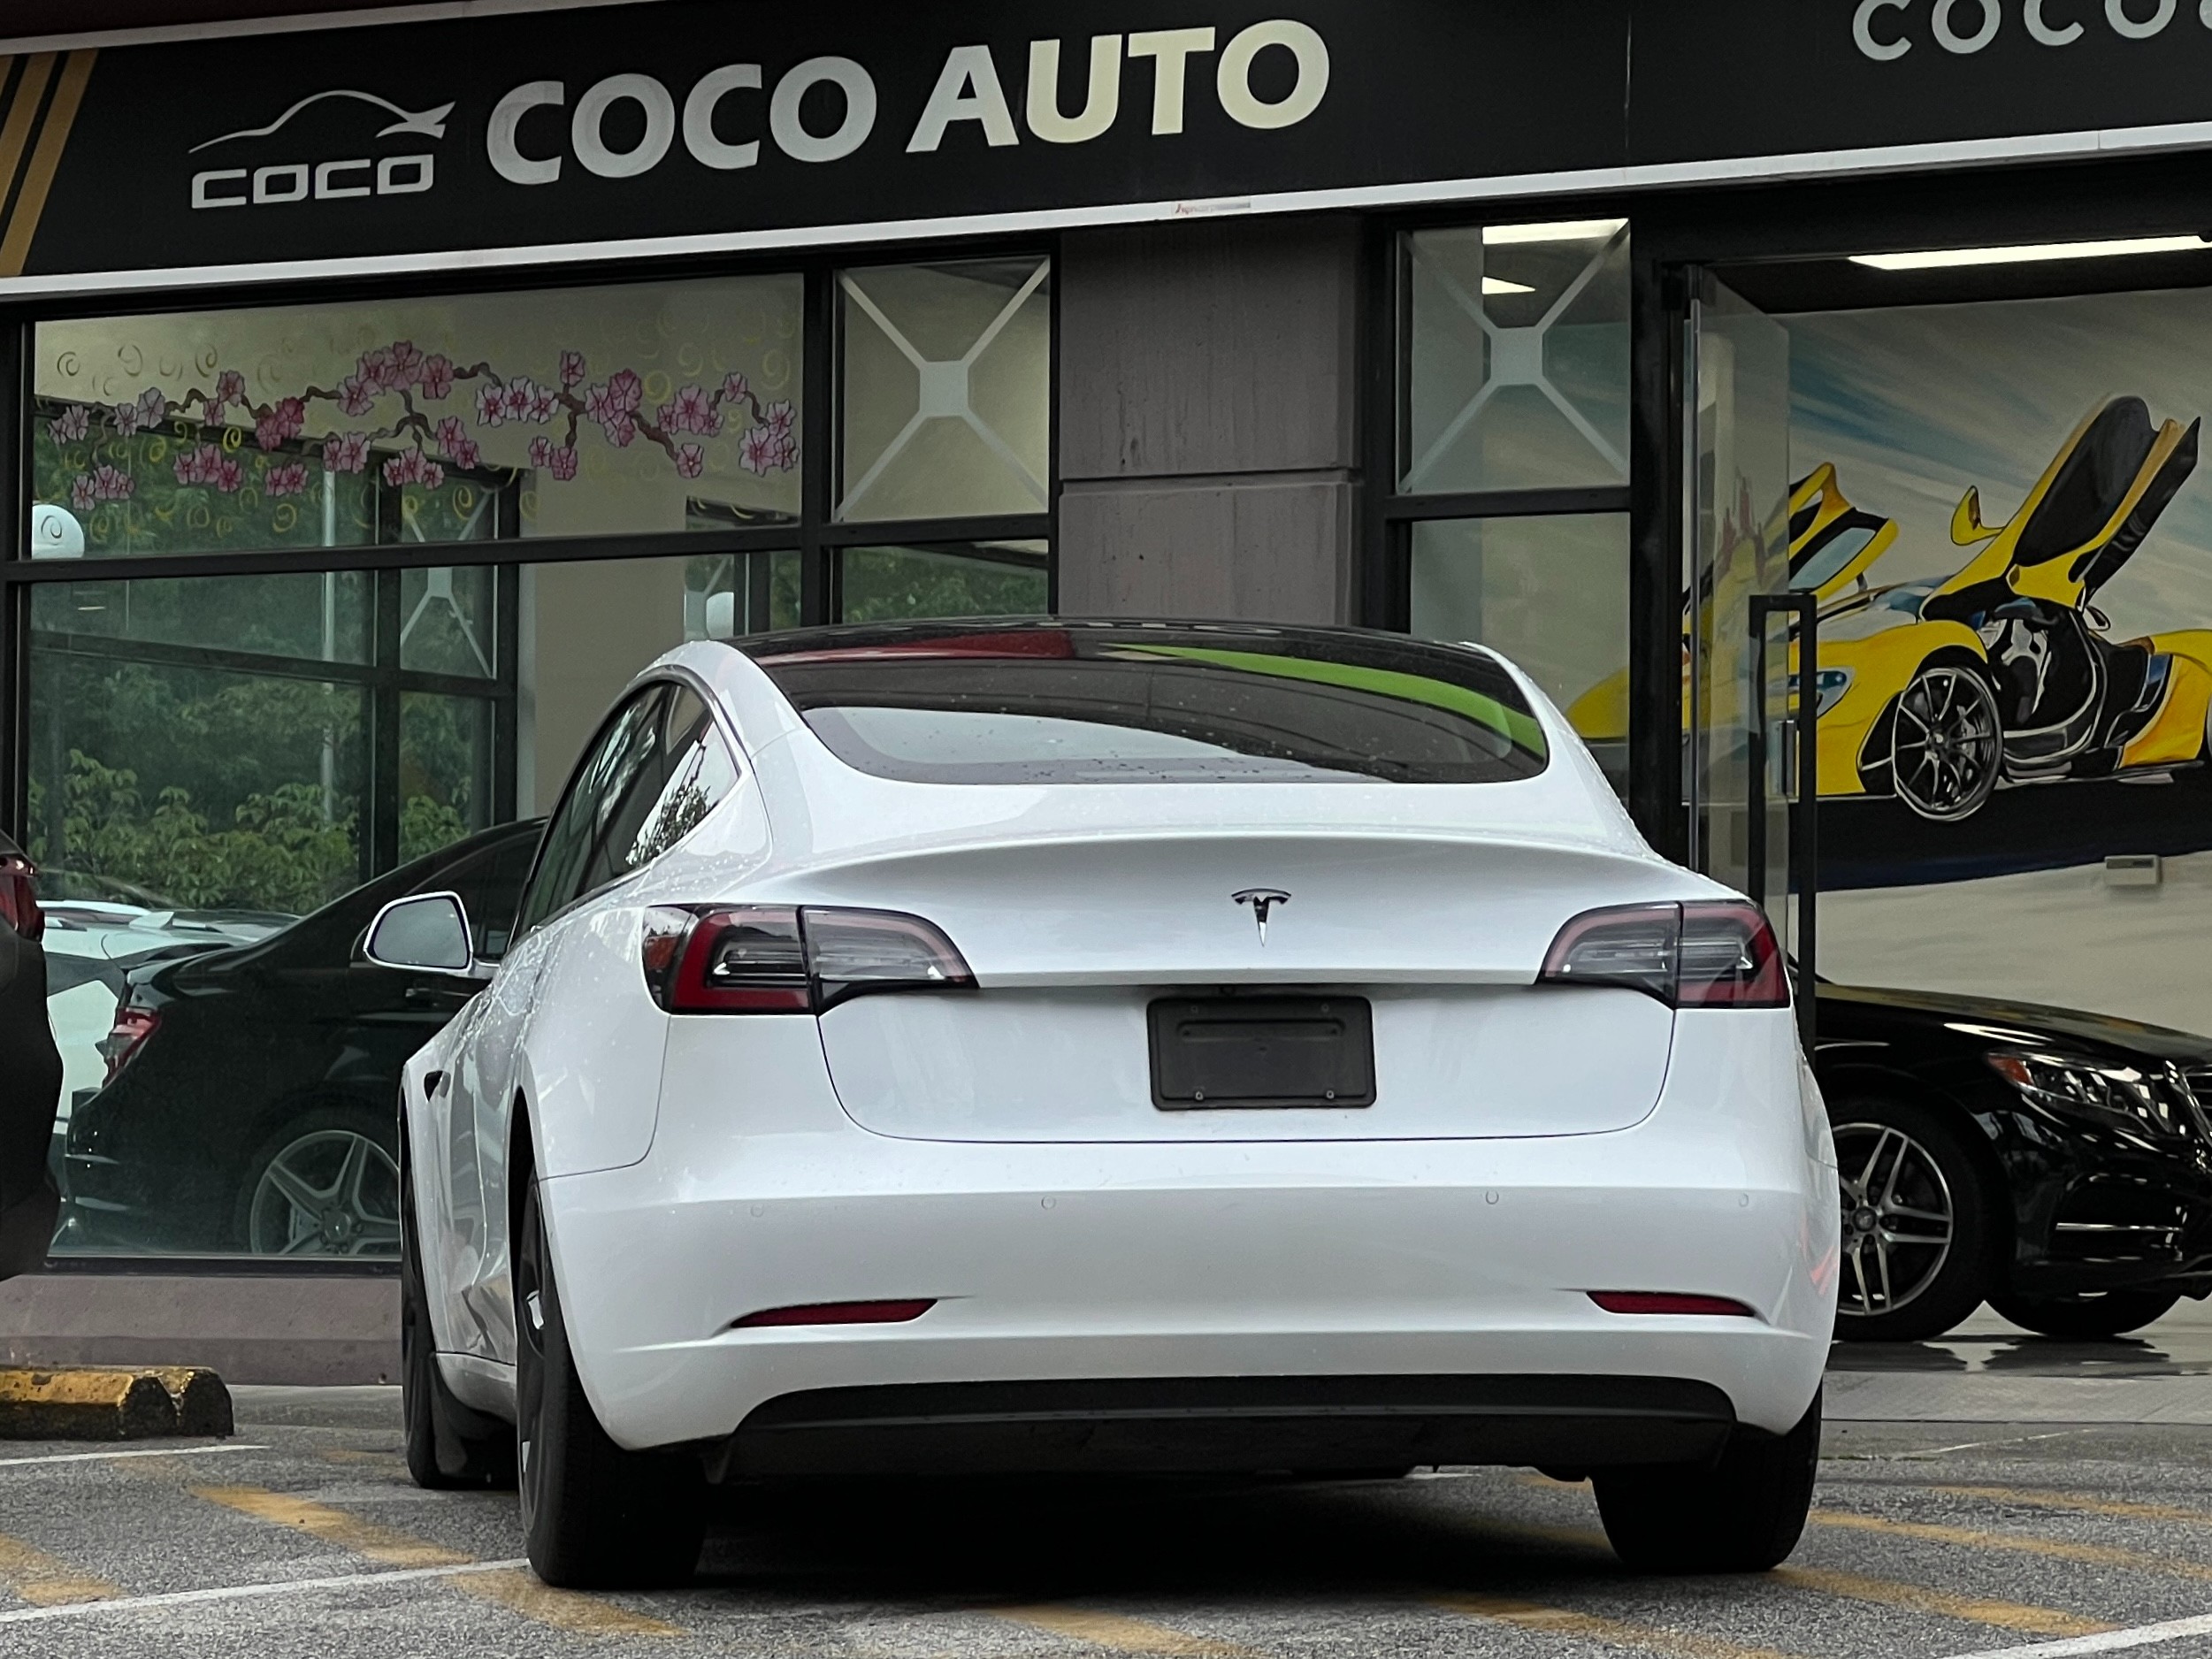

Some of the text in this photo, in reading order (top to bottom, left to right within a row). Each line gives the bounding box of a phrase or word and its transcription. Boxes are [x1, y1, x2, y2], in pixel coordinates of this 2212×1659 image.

[1852, 0, 2212, 61] COCO
[486, 19, 1330, 185] COCO AUTO
[191, 154, 434, 209] COCO
